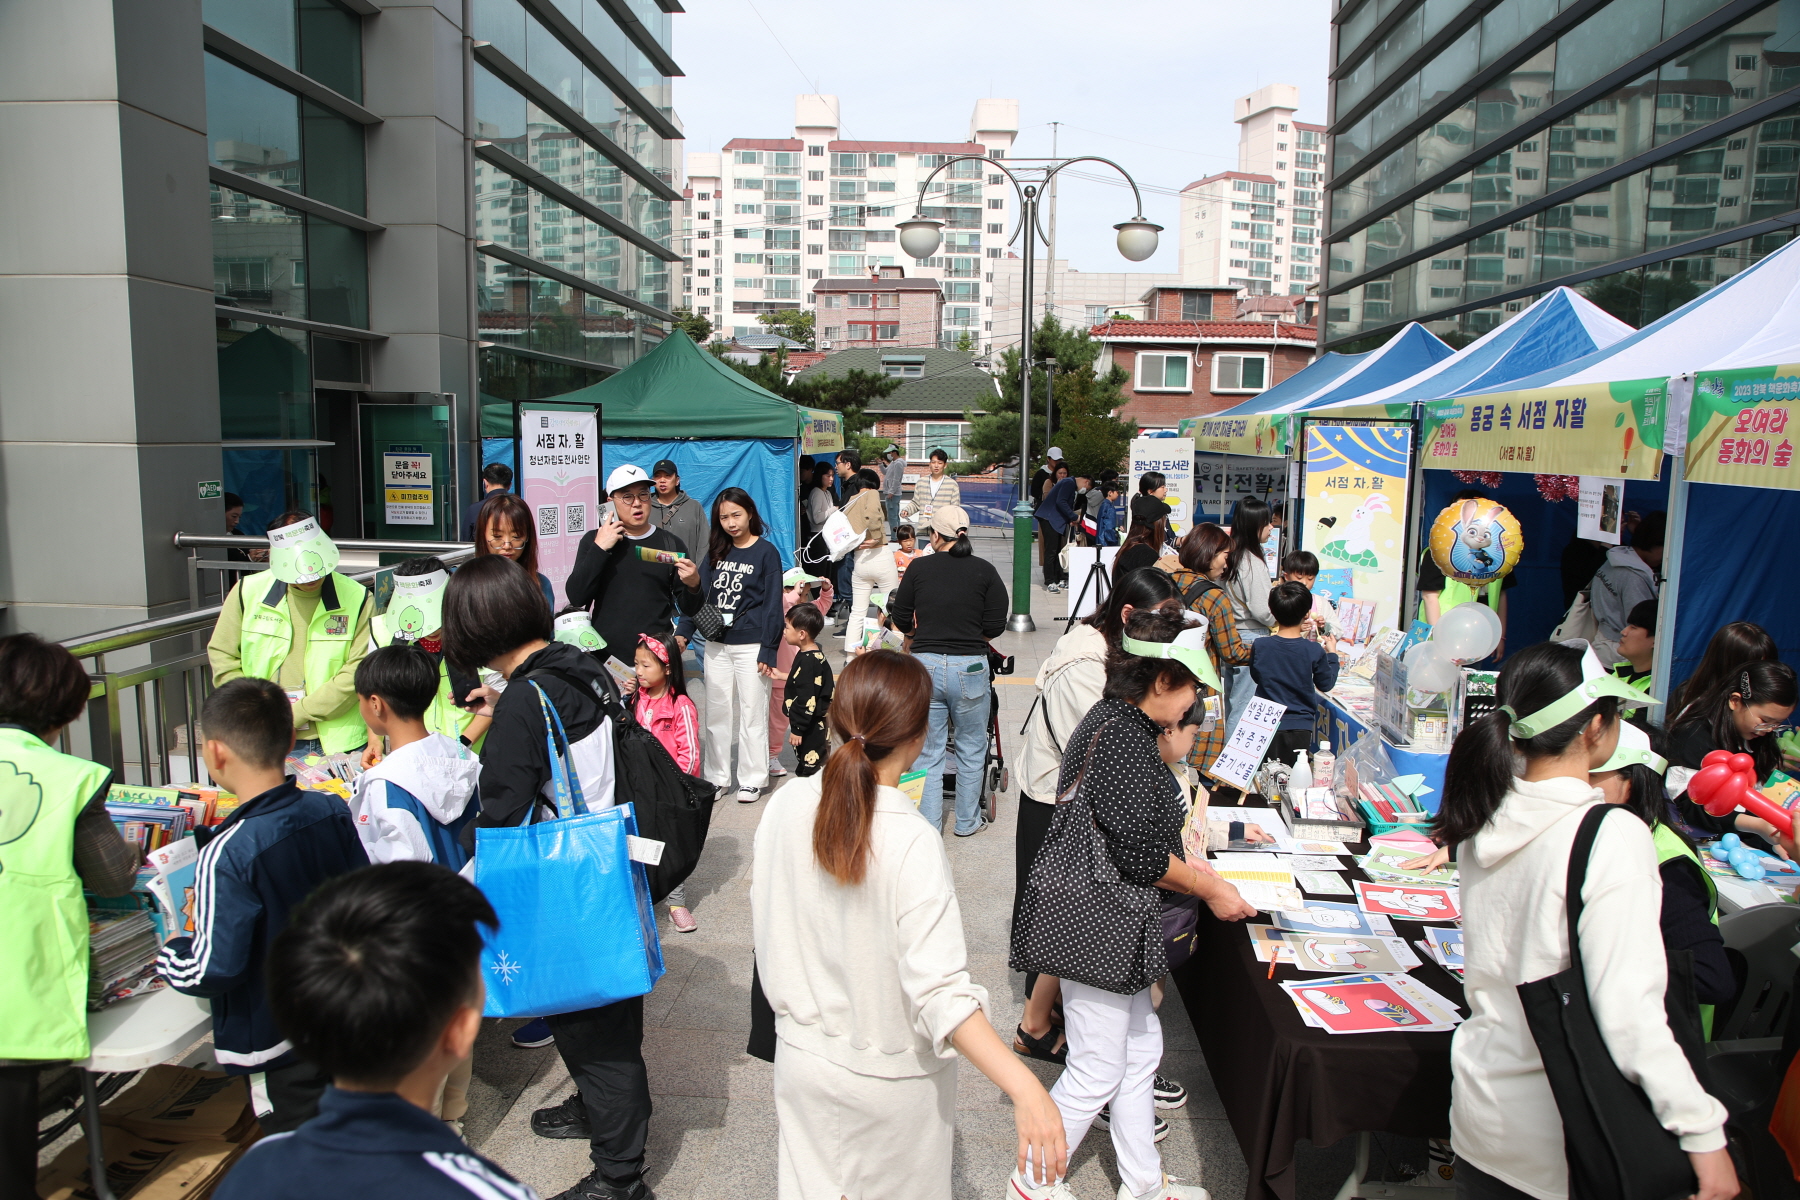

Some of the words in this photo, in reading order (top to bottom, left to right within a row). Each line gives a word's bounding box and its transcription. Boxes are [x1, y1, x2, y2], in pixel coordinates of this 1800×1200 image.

[1734, 385, 1751, 397] 2023
[1752, 383, 1767, 395] 강북
[1470, 405, 1494, 432] 용궁
[1500, 403, 1512, 431] 속
[1517, 400, 1547, 430] 서점
[1553, 398, 1587, 429] 자활
[1734, 408, 1788, 434] 모여라
[536, 433, 555, 449] 서점
[575, 432, 585, 449] 활
[1717, 438, 1771, 465] 동화의
[1772, 438, 1794, 467] 숲
[395, 461, 409, 470] 문을
[411, 461, 421, 470] 꼭!
[529, 454, 591, 466] 청년자립도전사업단
[1134, 460, 1161, 471] 장난감
[1162, 460, 1190, 471] 도서관
[391, 471, 427, 480] 닫아주세요
[207, 484, 217, 492] AED
[1325, 476, 1349, 489] 서점
[716, 560, 754, 574] D'ARLING
[400, 579, 432, 588] 책문화축제
